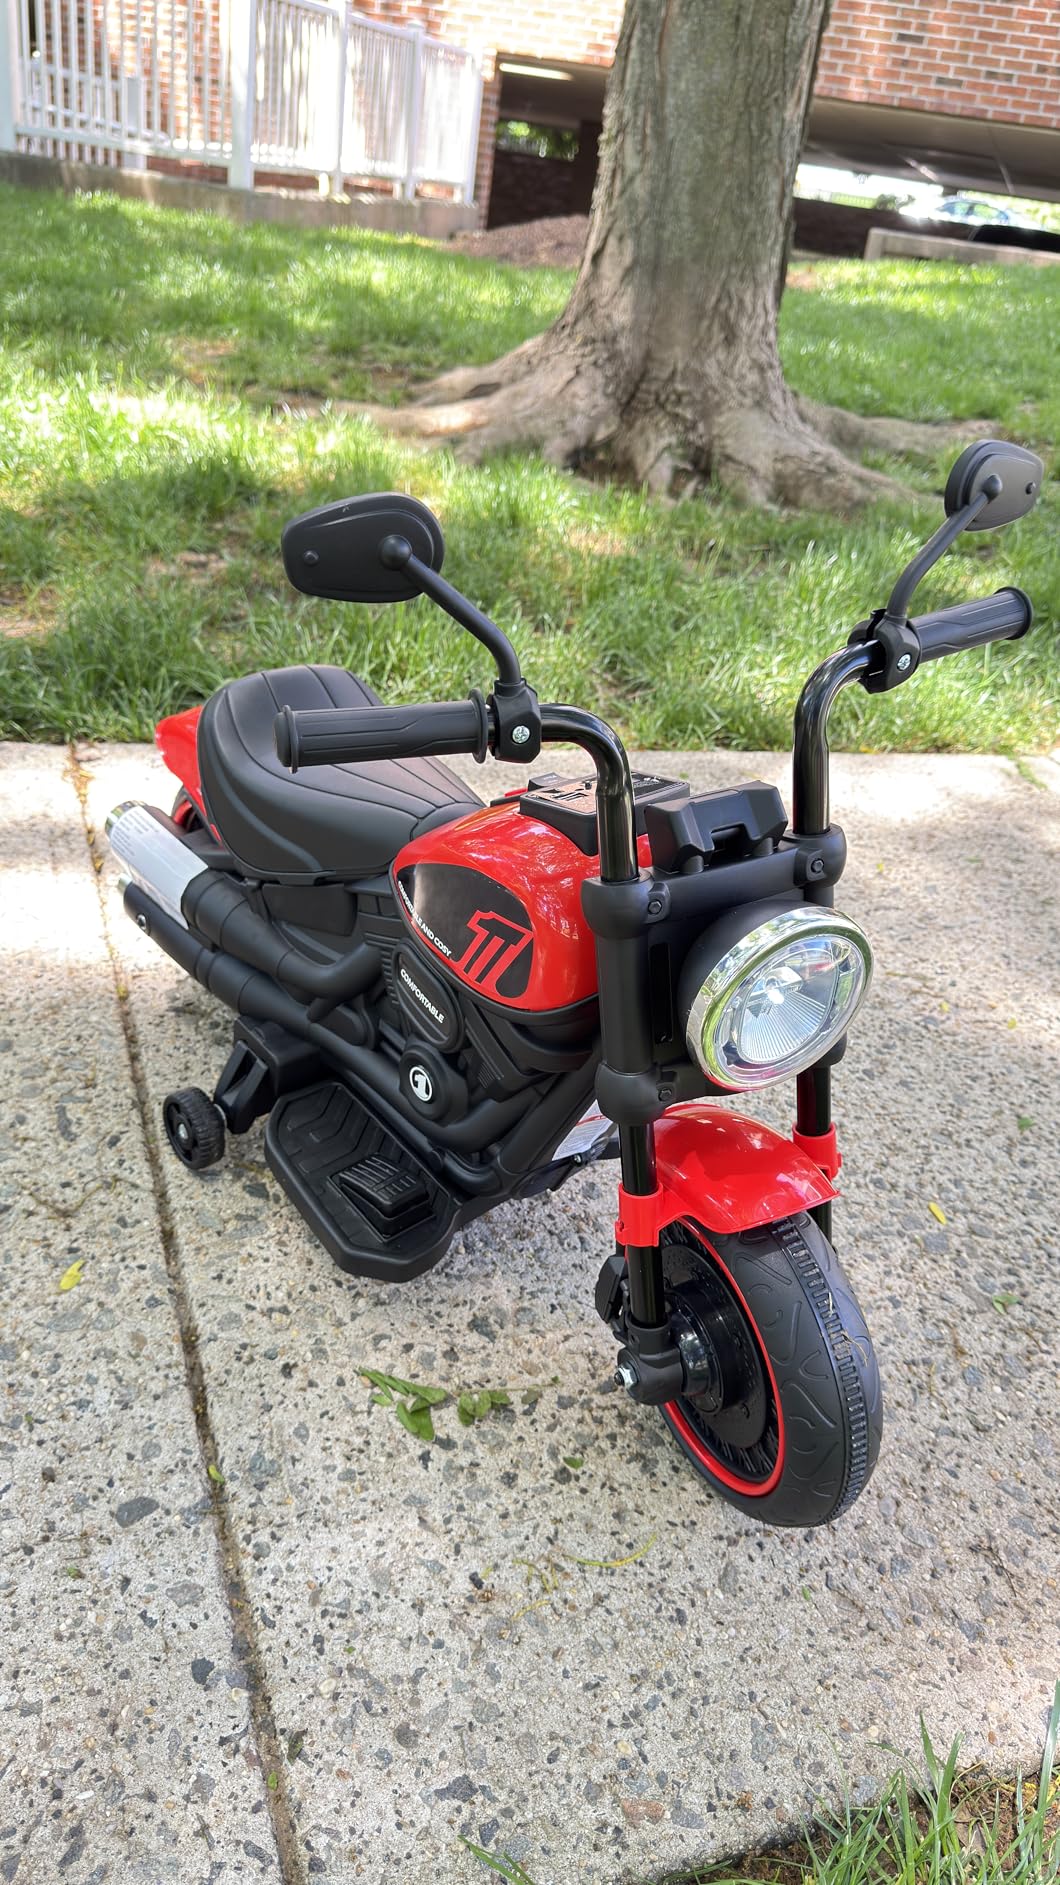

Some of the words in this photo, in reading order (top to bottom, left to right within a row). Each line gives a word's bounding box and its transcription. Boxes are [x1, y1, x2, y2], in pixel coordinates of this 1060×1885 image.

[421, 922, 435, 940] AND
[433, 936, 452, 957] COSY
[400, 968, 445, 1024] COMFORTABLE
[413, 1070, 430, 1100] 1
